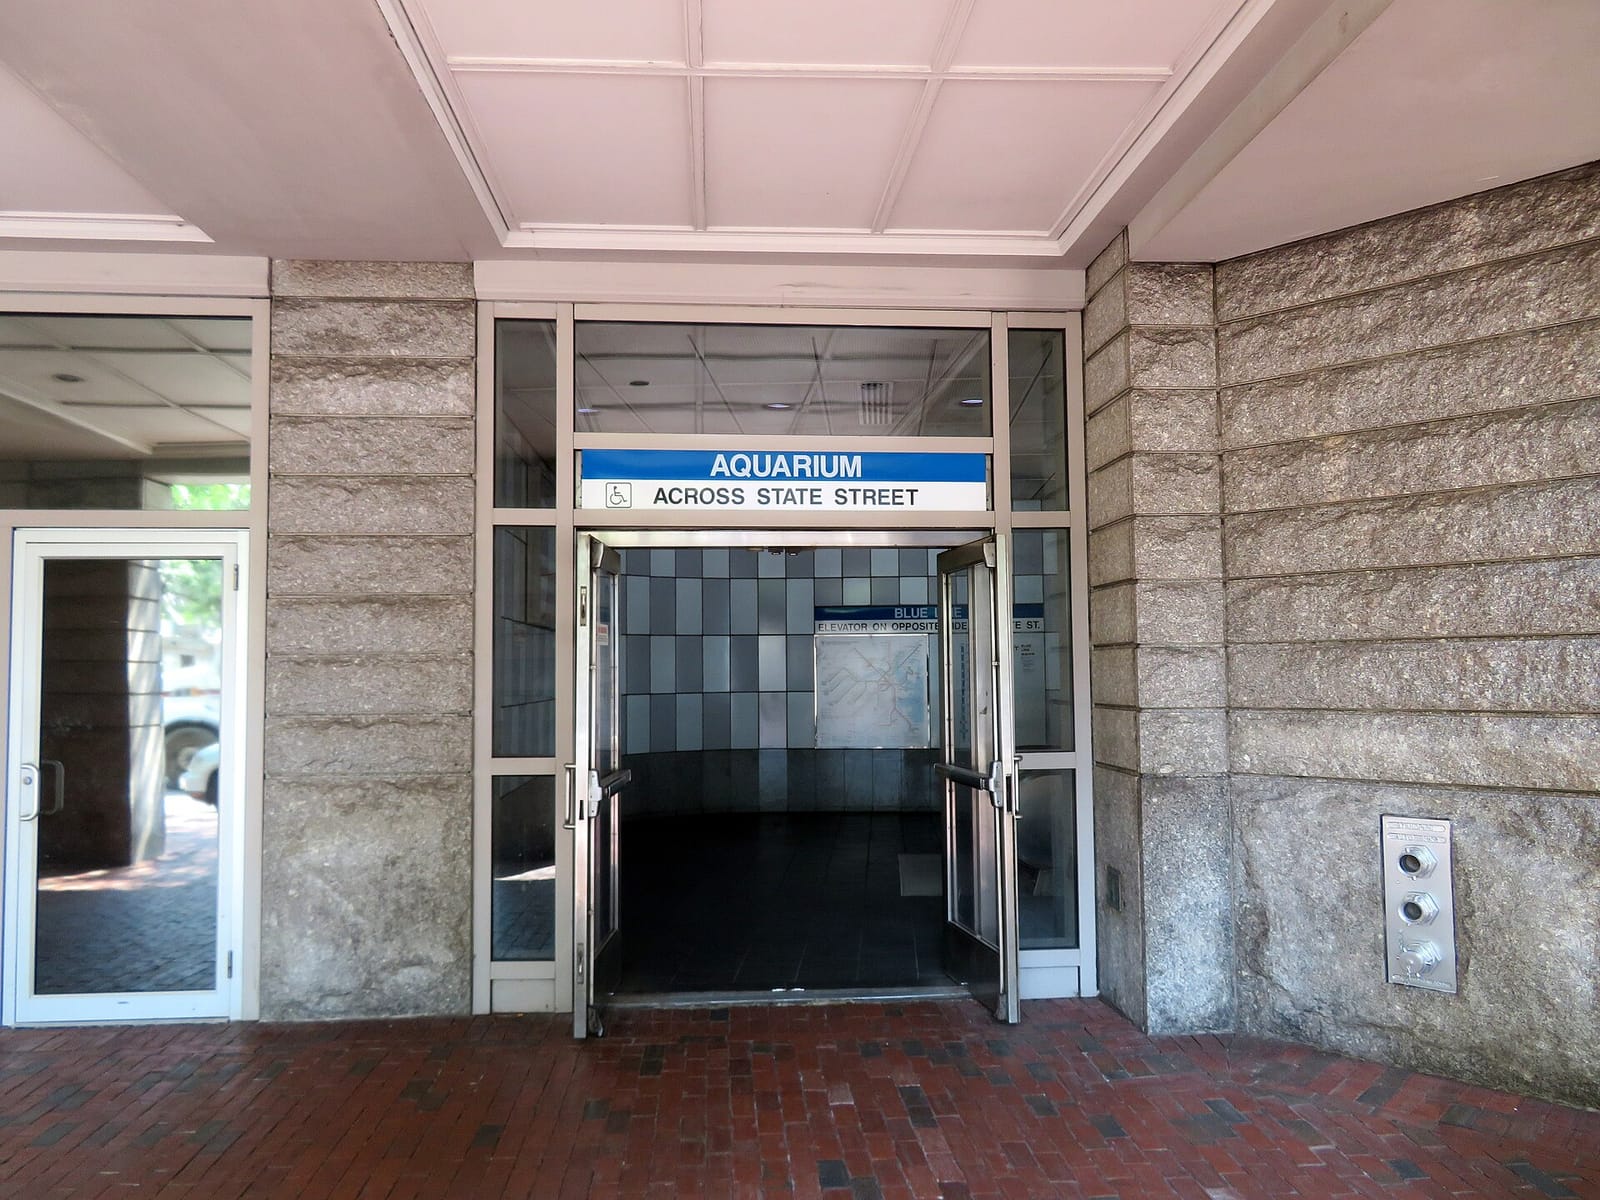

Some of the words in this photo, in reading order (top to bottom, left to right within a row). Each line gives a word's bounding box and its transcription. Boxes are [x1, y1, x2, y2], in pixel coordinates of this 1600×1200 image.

[710, 453, 862, 478] AQUARIUM
[653, 487, 745, 505] ACROSS
[757, 488, 822, 505] STATE
[834, 488, 919, 505] STREET
[894, 607, 928, 618] BLUE
[818, 623, 868, 632] ELEVATOR
[872, 623, 887, 631] ON
